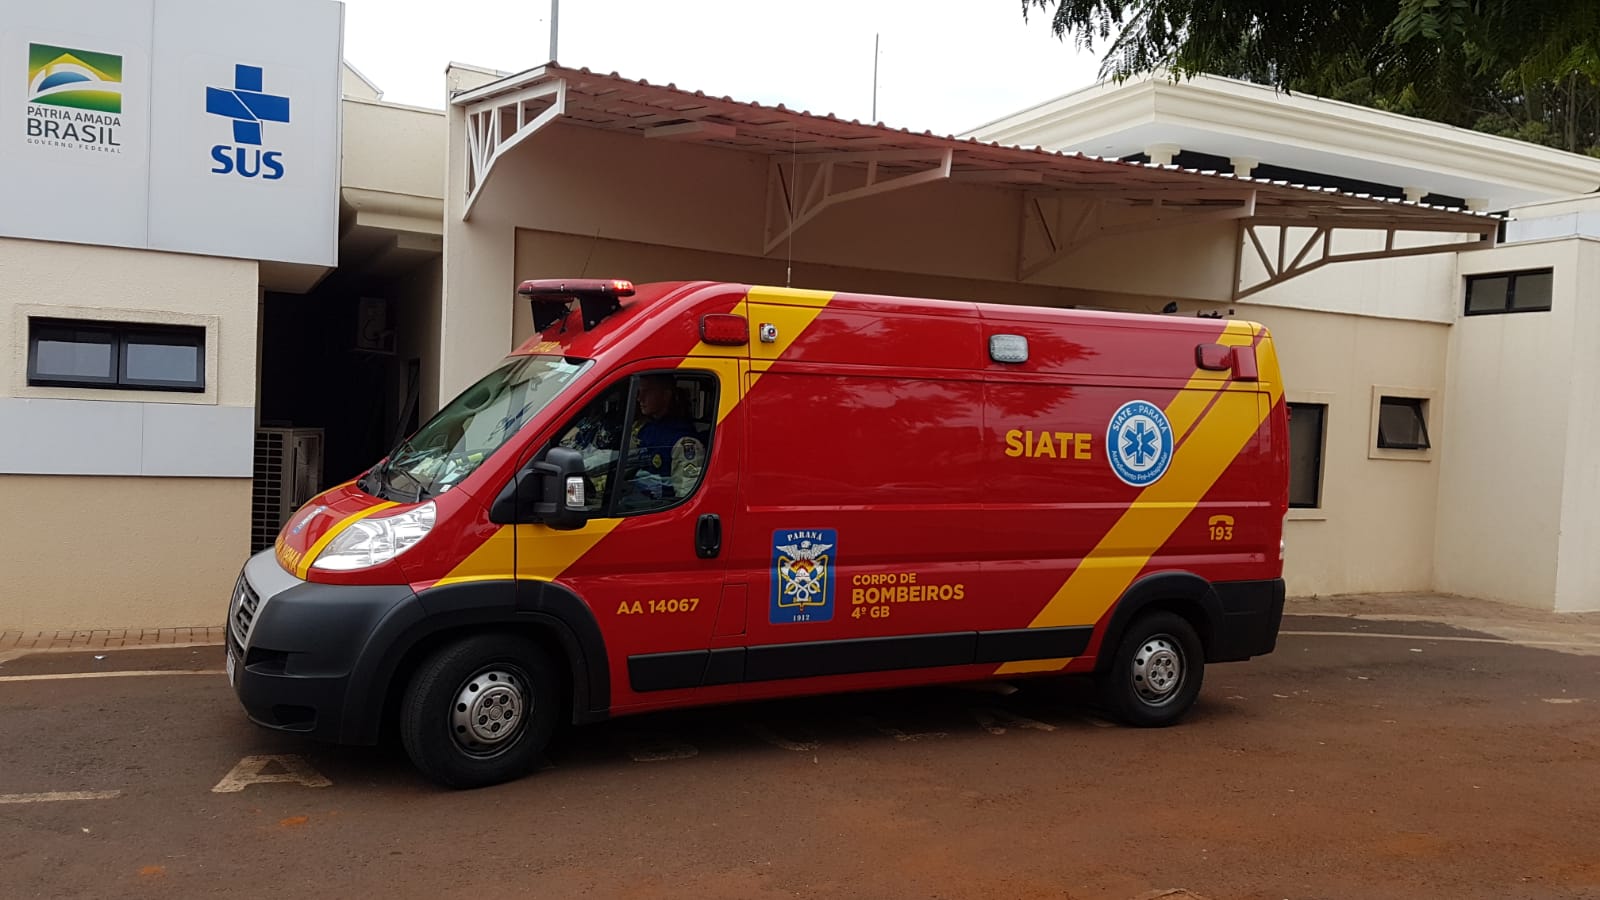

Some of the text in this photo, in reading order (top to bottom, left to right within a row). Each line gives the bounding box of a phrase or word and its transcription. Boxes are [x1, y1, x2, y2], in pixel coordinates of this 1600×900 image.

[27, 105, 121, 126] PÁTRIA AMADA
[26, 117, 121, 146] BRASIL
[27, 138, 121, 154] GOVERNO FEDERAL
[211, 145, 284, 180] SUS
[1113, 408, 1131, 431] SIATE
[1005, 430, 1092, 459] SIATE
[1209, 526, 1233, 541] 193
[853, 573, 917, 586] CORPO DE
[852, 584, 964, 604] BOMBEIROS
[616, 598, 699, 615] AA 14067
[870, 606, 890, 618] GB
[793, 614, 811, 622] 1912
